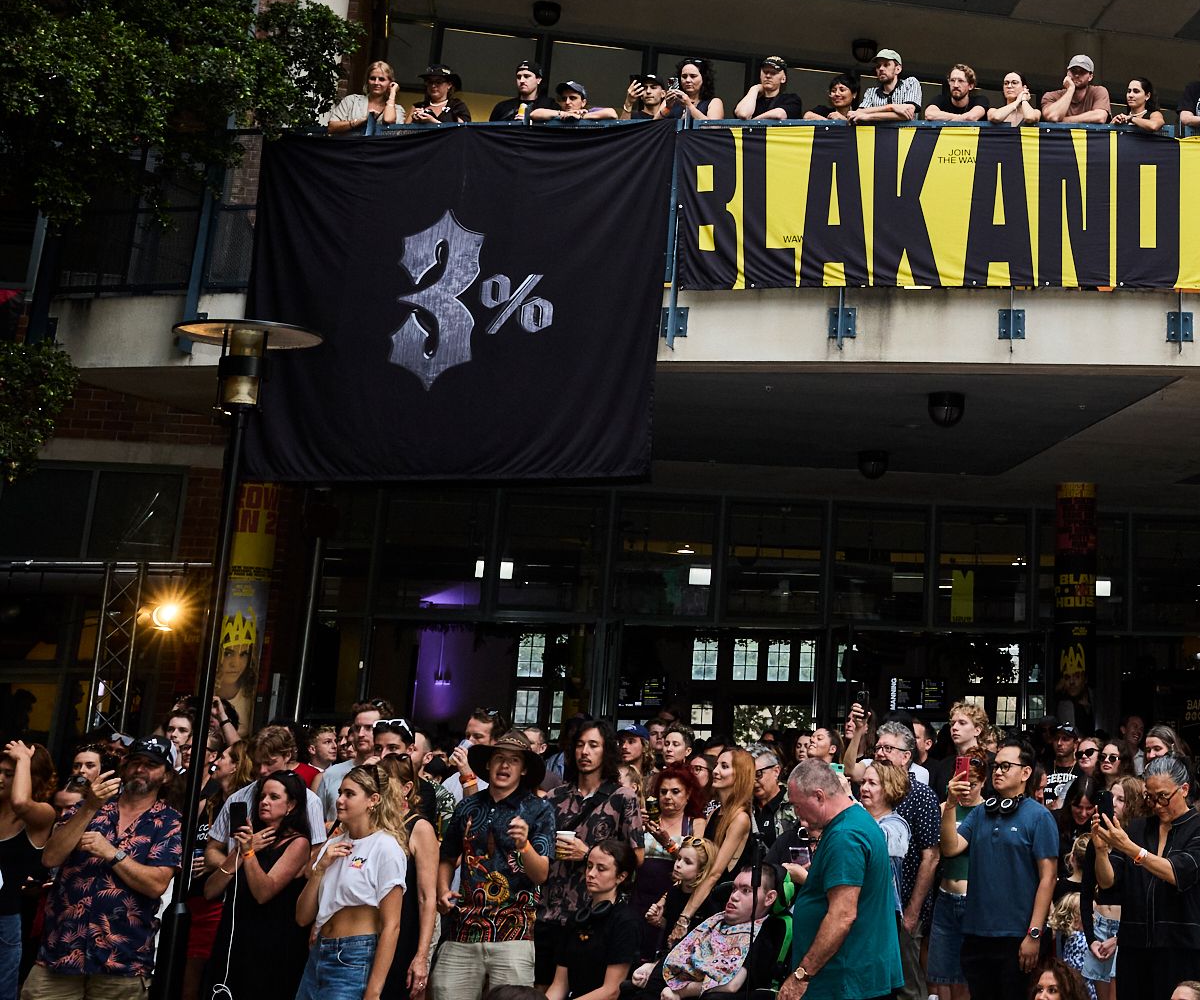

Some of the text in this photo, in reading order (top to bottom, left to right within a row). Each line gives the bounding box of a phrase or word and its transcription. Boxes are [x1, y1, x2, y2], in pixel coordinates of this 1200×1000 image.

[937, 156, 957, 164] THE
[948, 149, 971, 157] JOIN
[677, 127, 941, 290] BLAK
[963, 127, 1181, 291] AND
[387, 209, 554, 392] 3%
